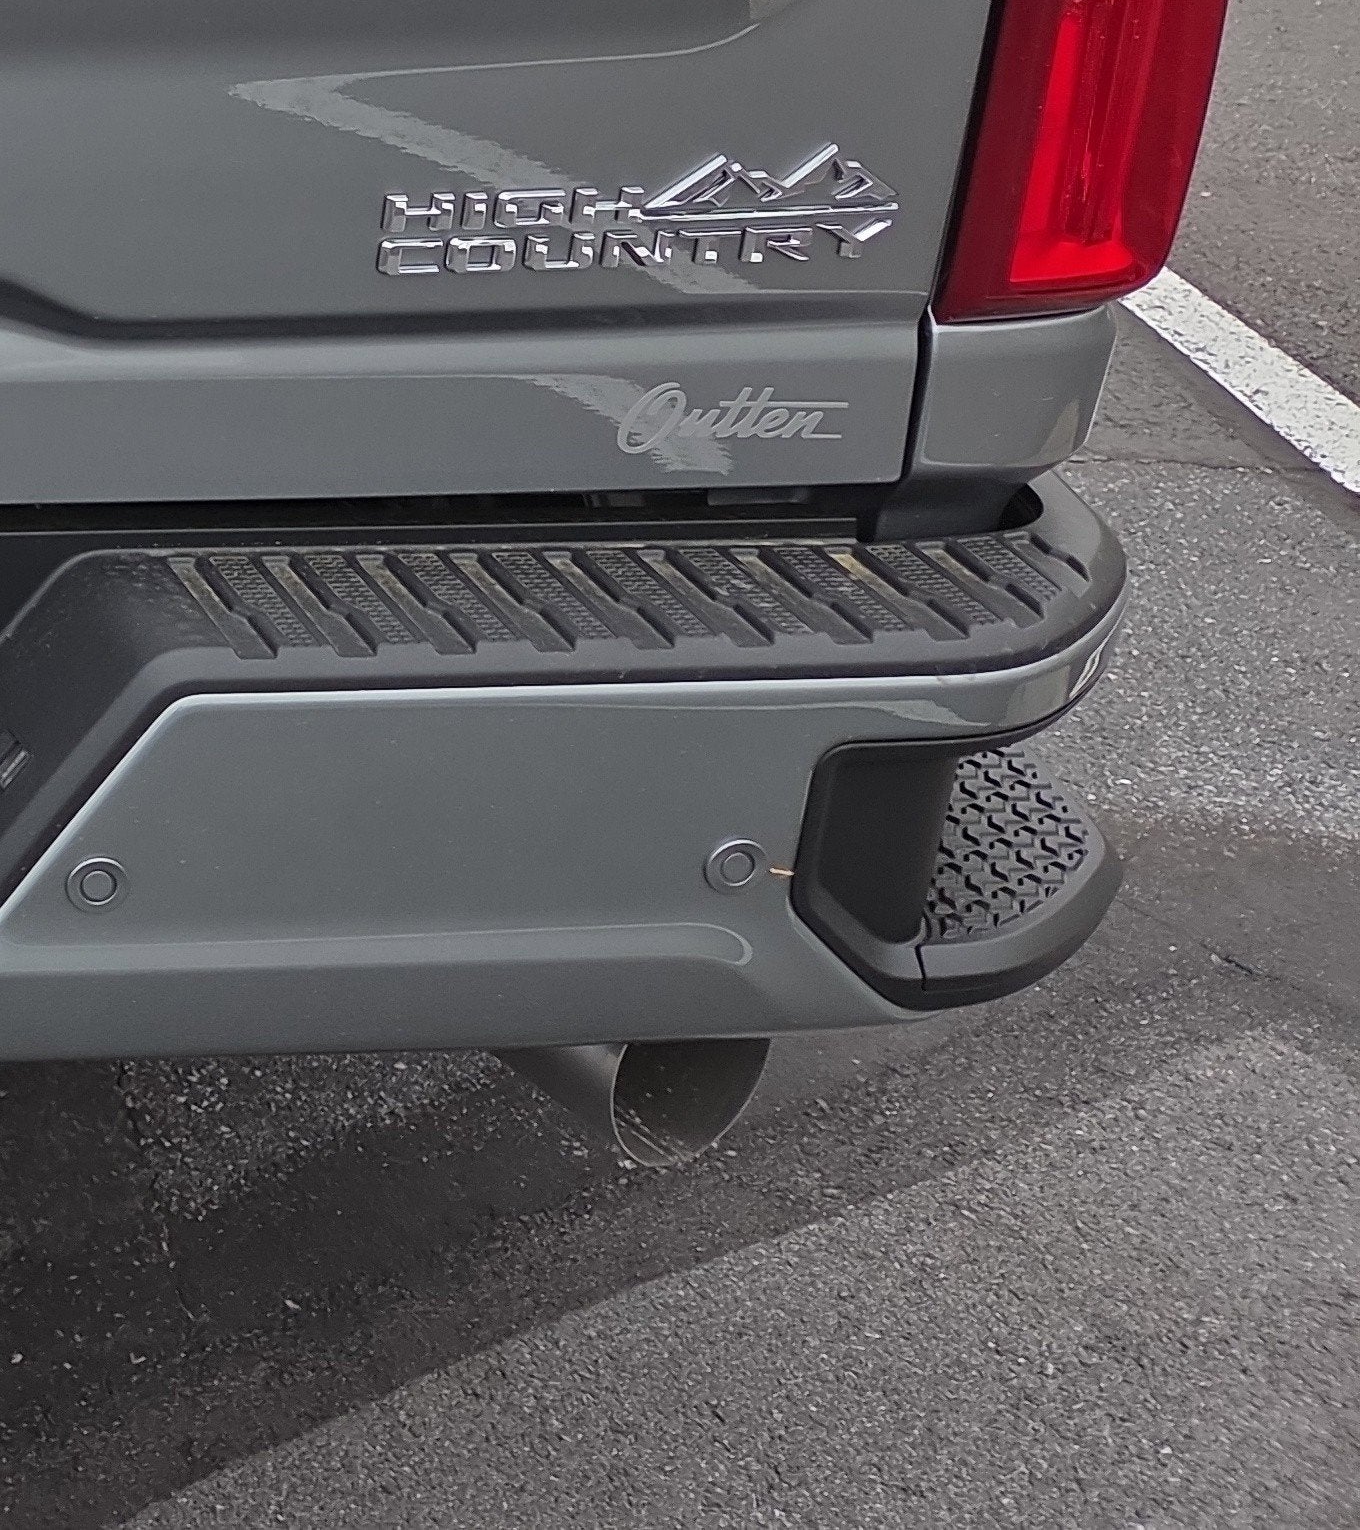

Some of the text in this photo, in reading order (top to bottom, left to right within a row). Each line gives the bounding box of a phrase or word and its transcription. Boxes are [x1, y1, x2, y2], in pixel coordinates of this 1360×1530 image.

[381, 185, 644, 232] HIGH
[376, 218, 894, 275] COUNTRY
[616, 381, 850, 455] Outten
